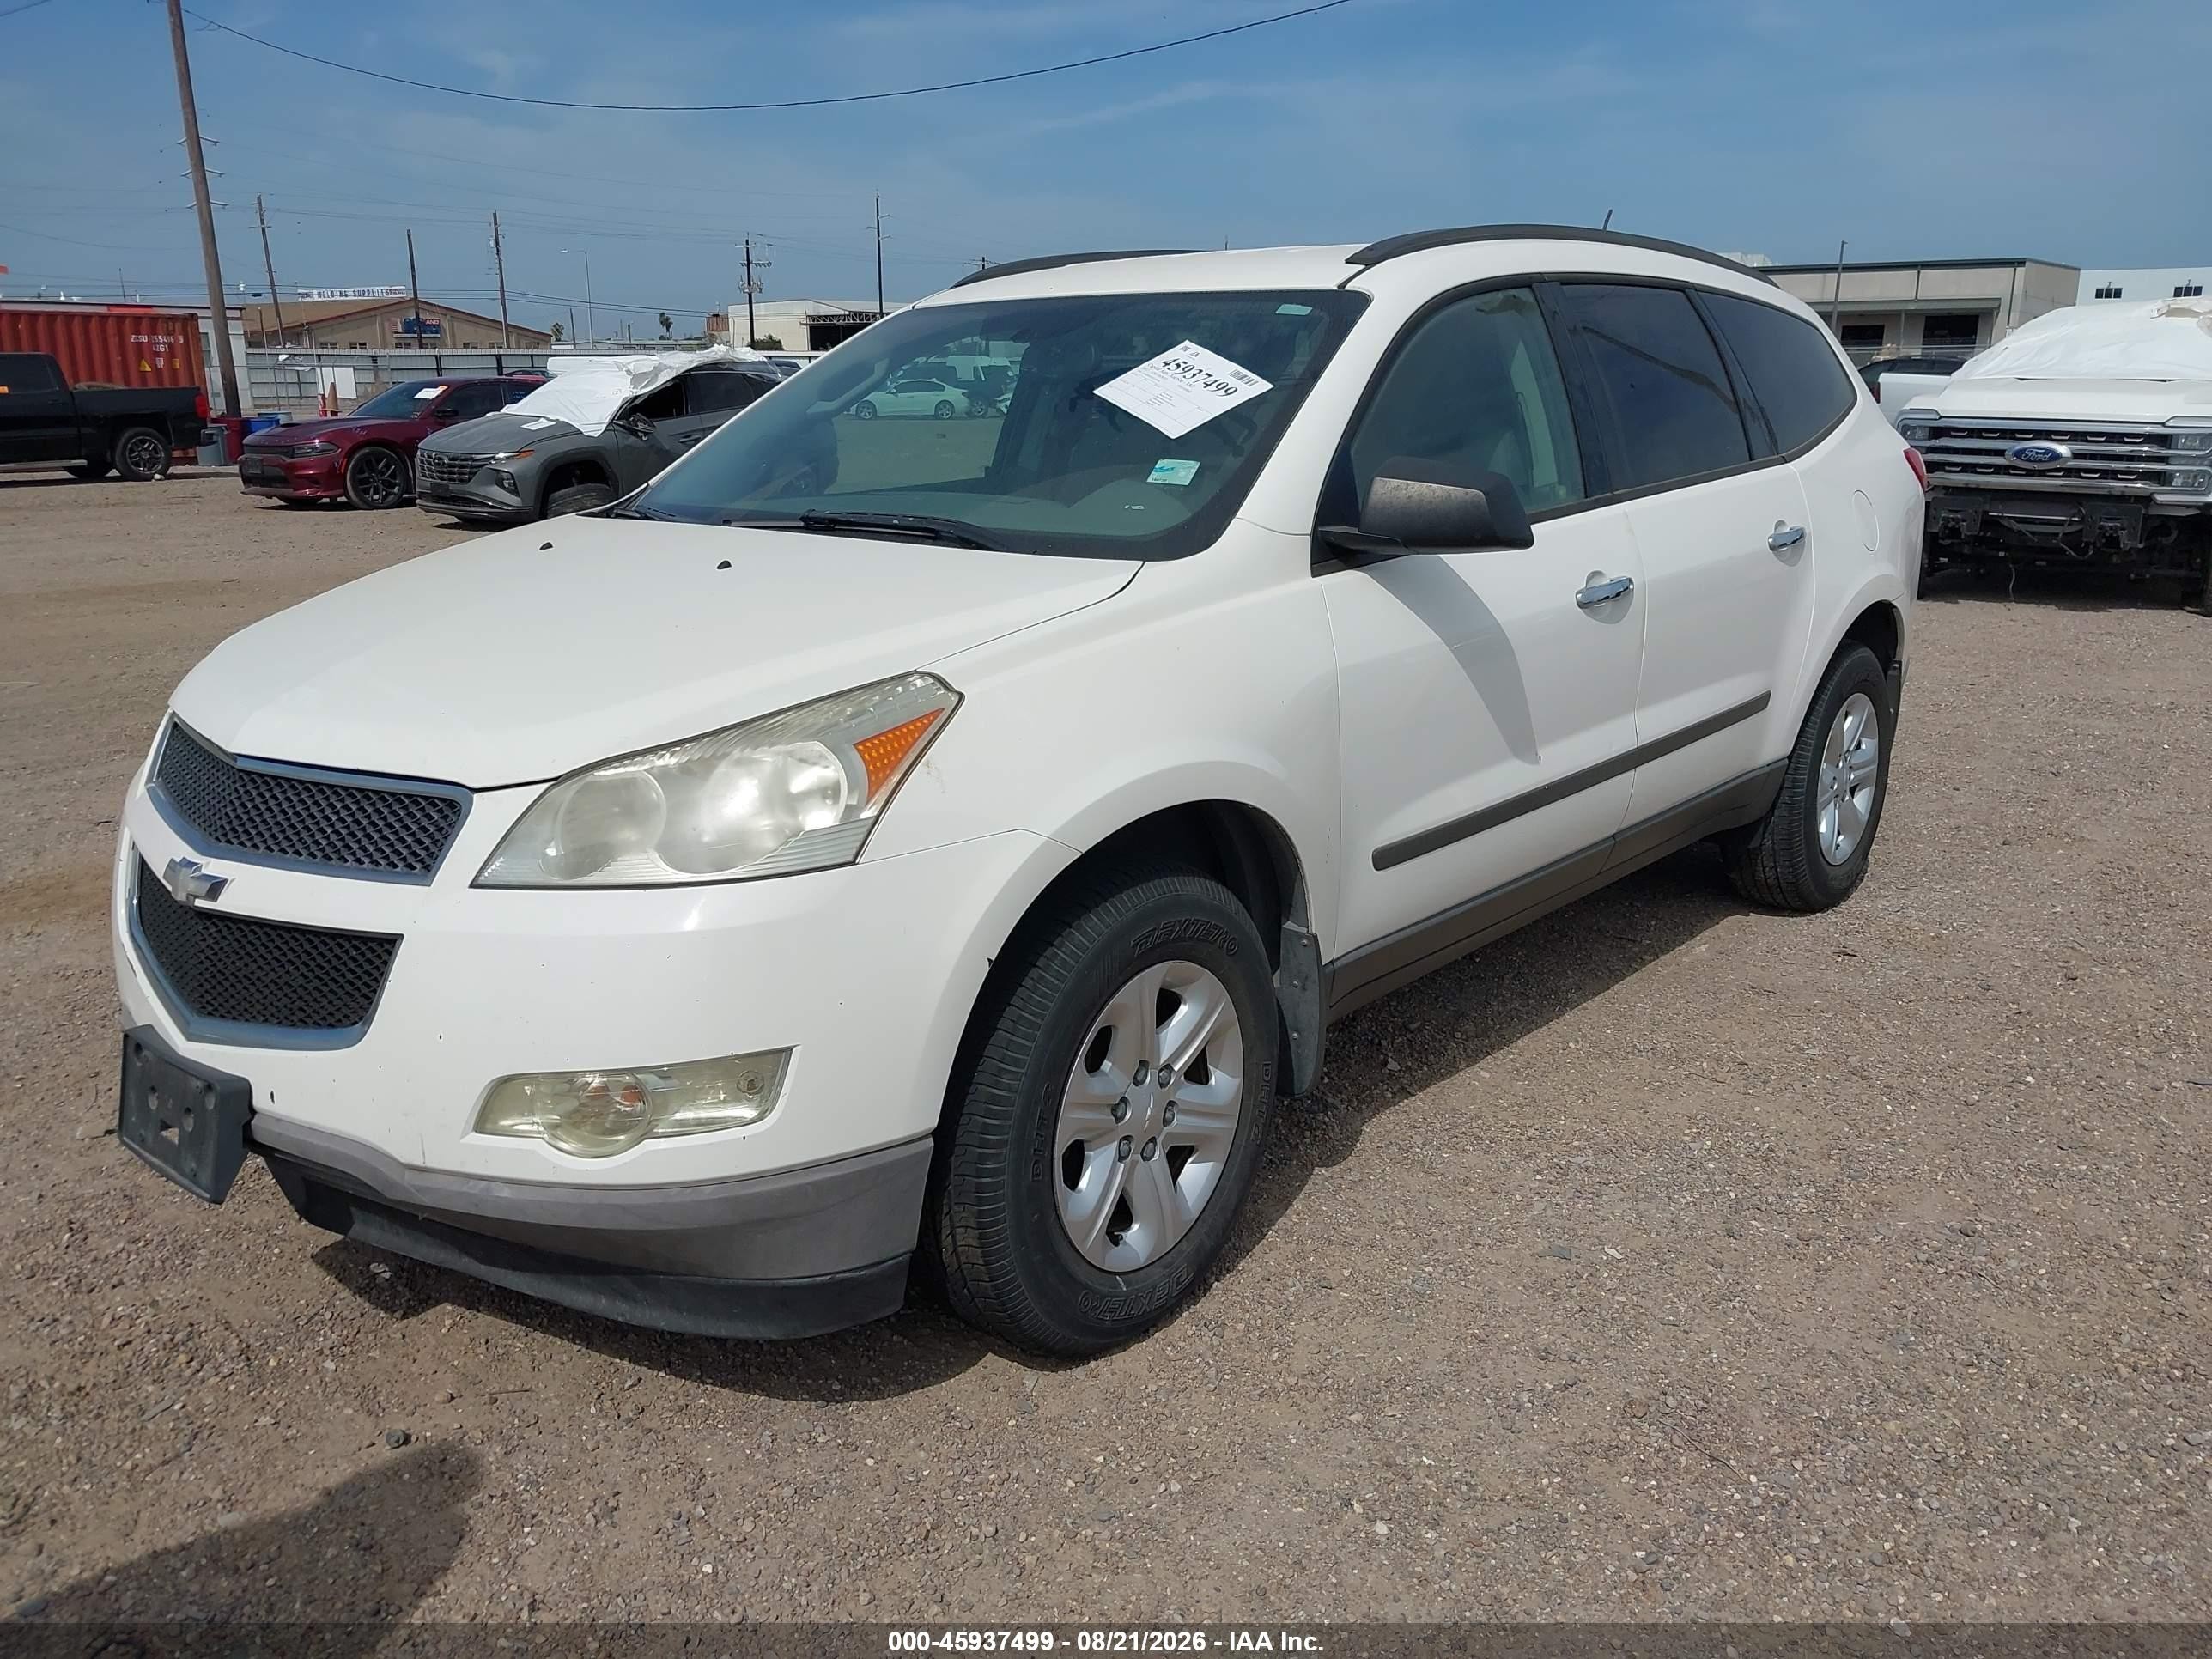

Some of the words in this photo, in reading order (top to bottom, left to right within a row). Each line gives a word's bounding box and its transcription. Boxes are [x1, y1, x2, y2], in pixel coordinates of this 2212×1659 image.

[1162, 358, 1238, 397] 45937499
[2021, 448, 2052, 461] Ford
[1130, 917, 1238, 956] DEXTERO
[1079, 1263, 1195, 1321] DEXTERO
